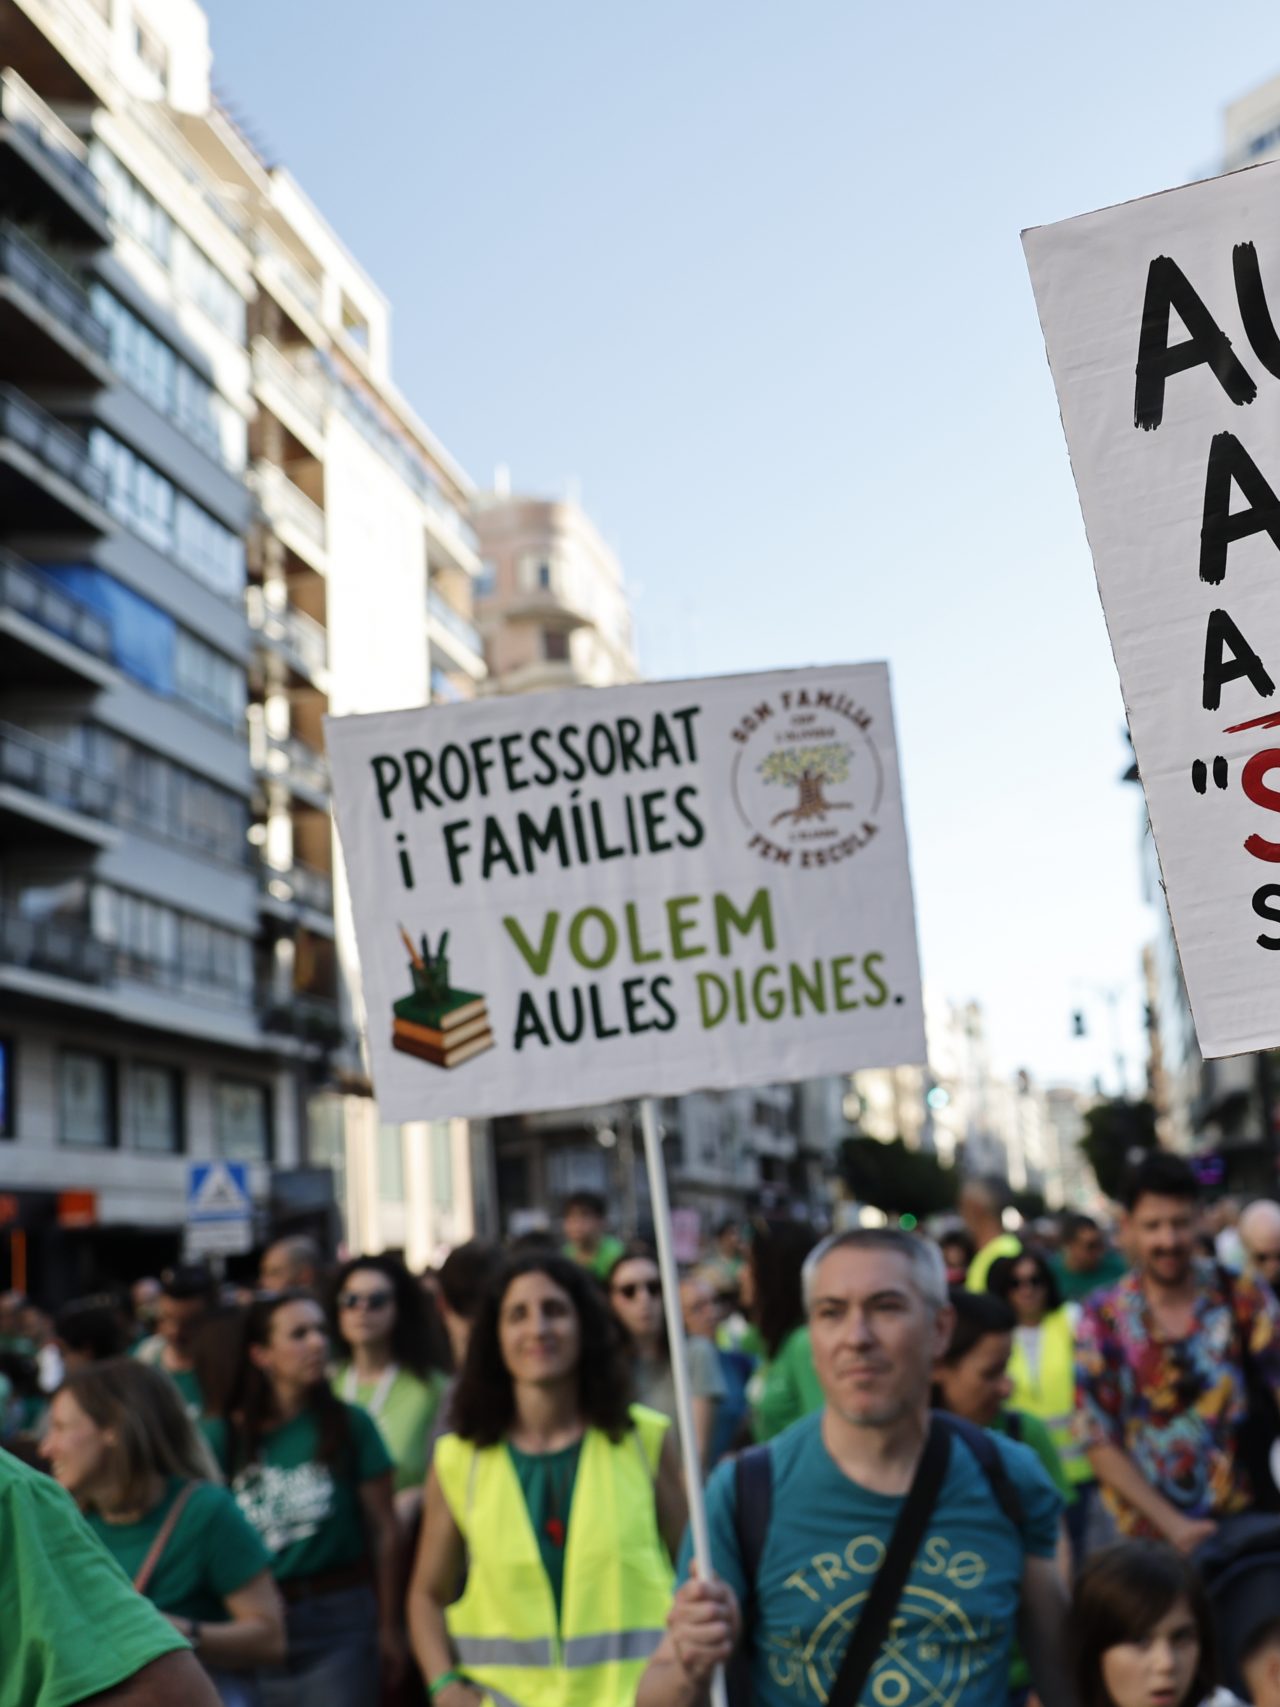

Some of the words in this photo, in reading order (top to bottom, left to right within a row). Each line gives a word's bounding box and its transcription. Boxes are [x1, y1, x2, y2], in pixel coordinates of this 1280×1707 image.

[1203, 608, 1276, 711] A
[370, 705, 703, 821] PROFESSORAT
[396, 832, 415, 891] i
[442, 785, 706, 886] FAMÍLIES
[502, 888, 777, 977] VOLEM
[513, 975, 679, 1052] AULES
[696, 952, 906, 1030] DIGNES.
[783, 1535, 987, 1602] TROSØ
